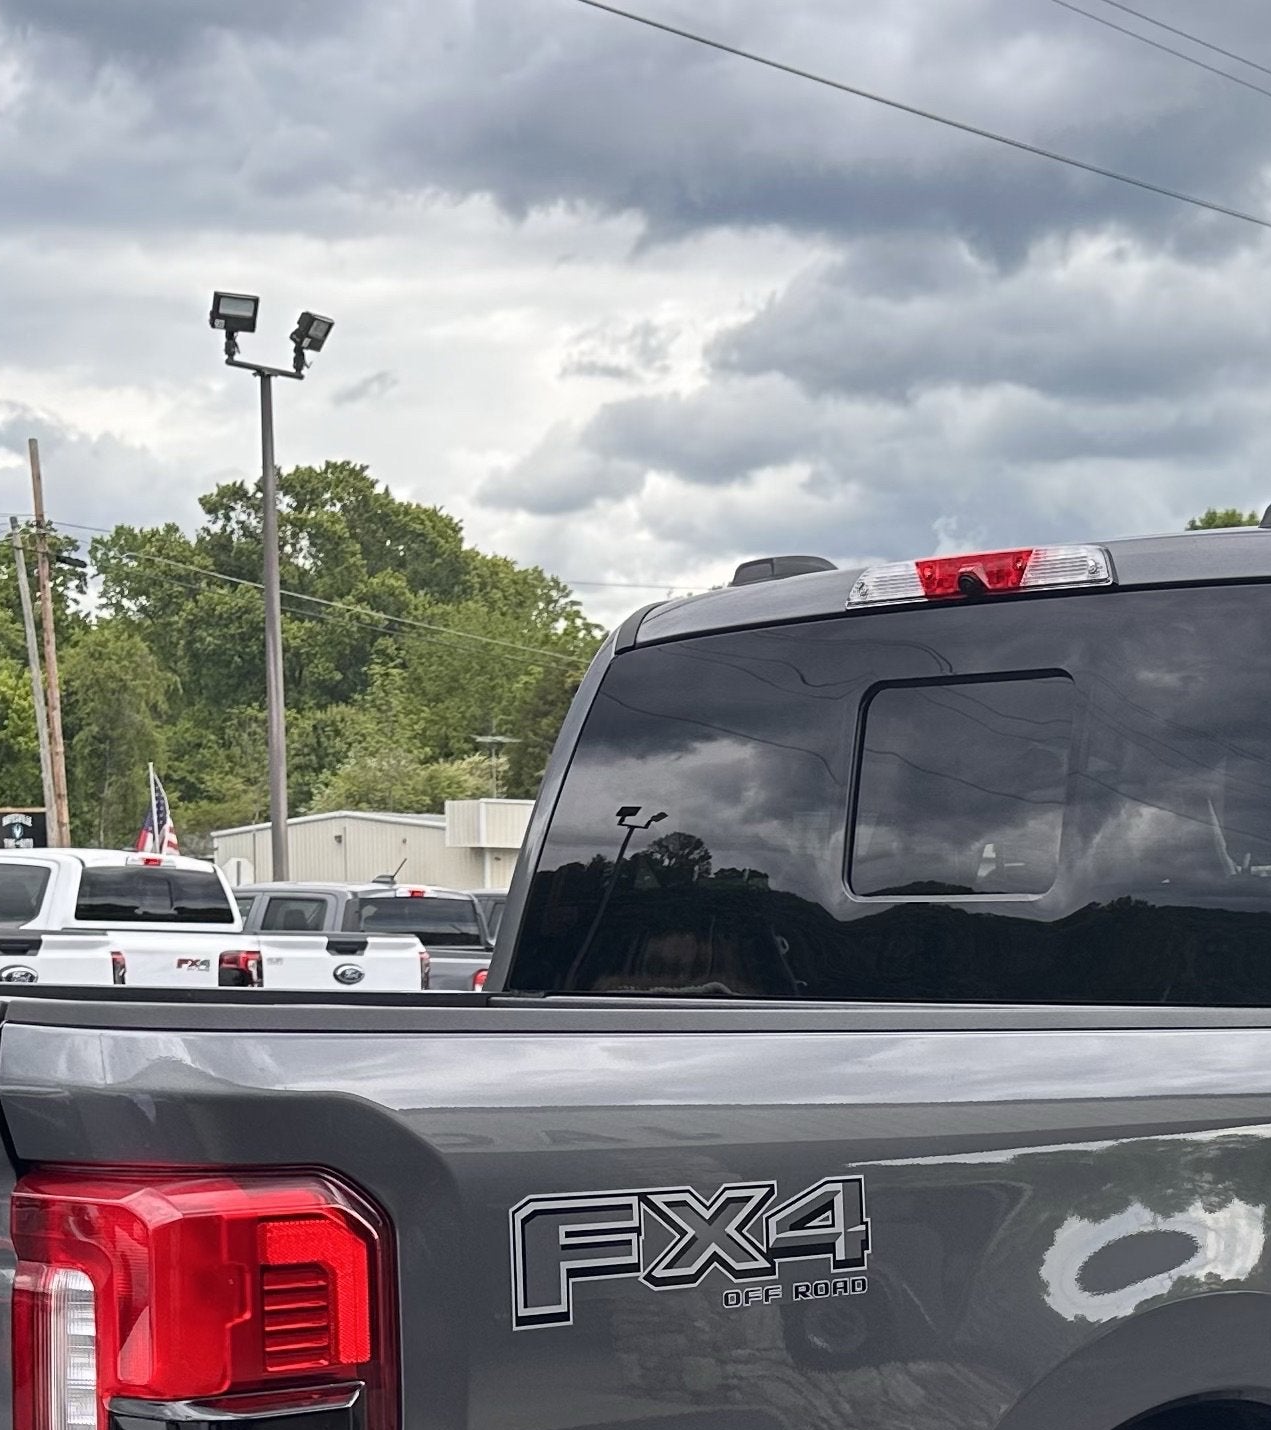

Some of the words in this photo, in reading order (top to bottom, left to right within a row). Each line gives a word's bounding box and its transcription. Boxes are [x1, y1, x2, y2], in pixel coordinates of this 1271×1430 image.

[509, 1175, 871, 1331] FX4
[723, 1285, 782, 1309] OFF
[793, 1276, 868, 1300] ROAD
